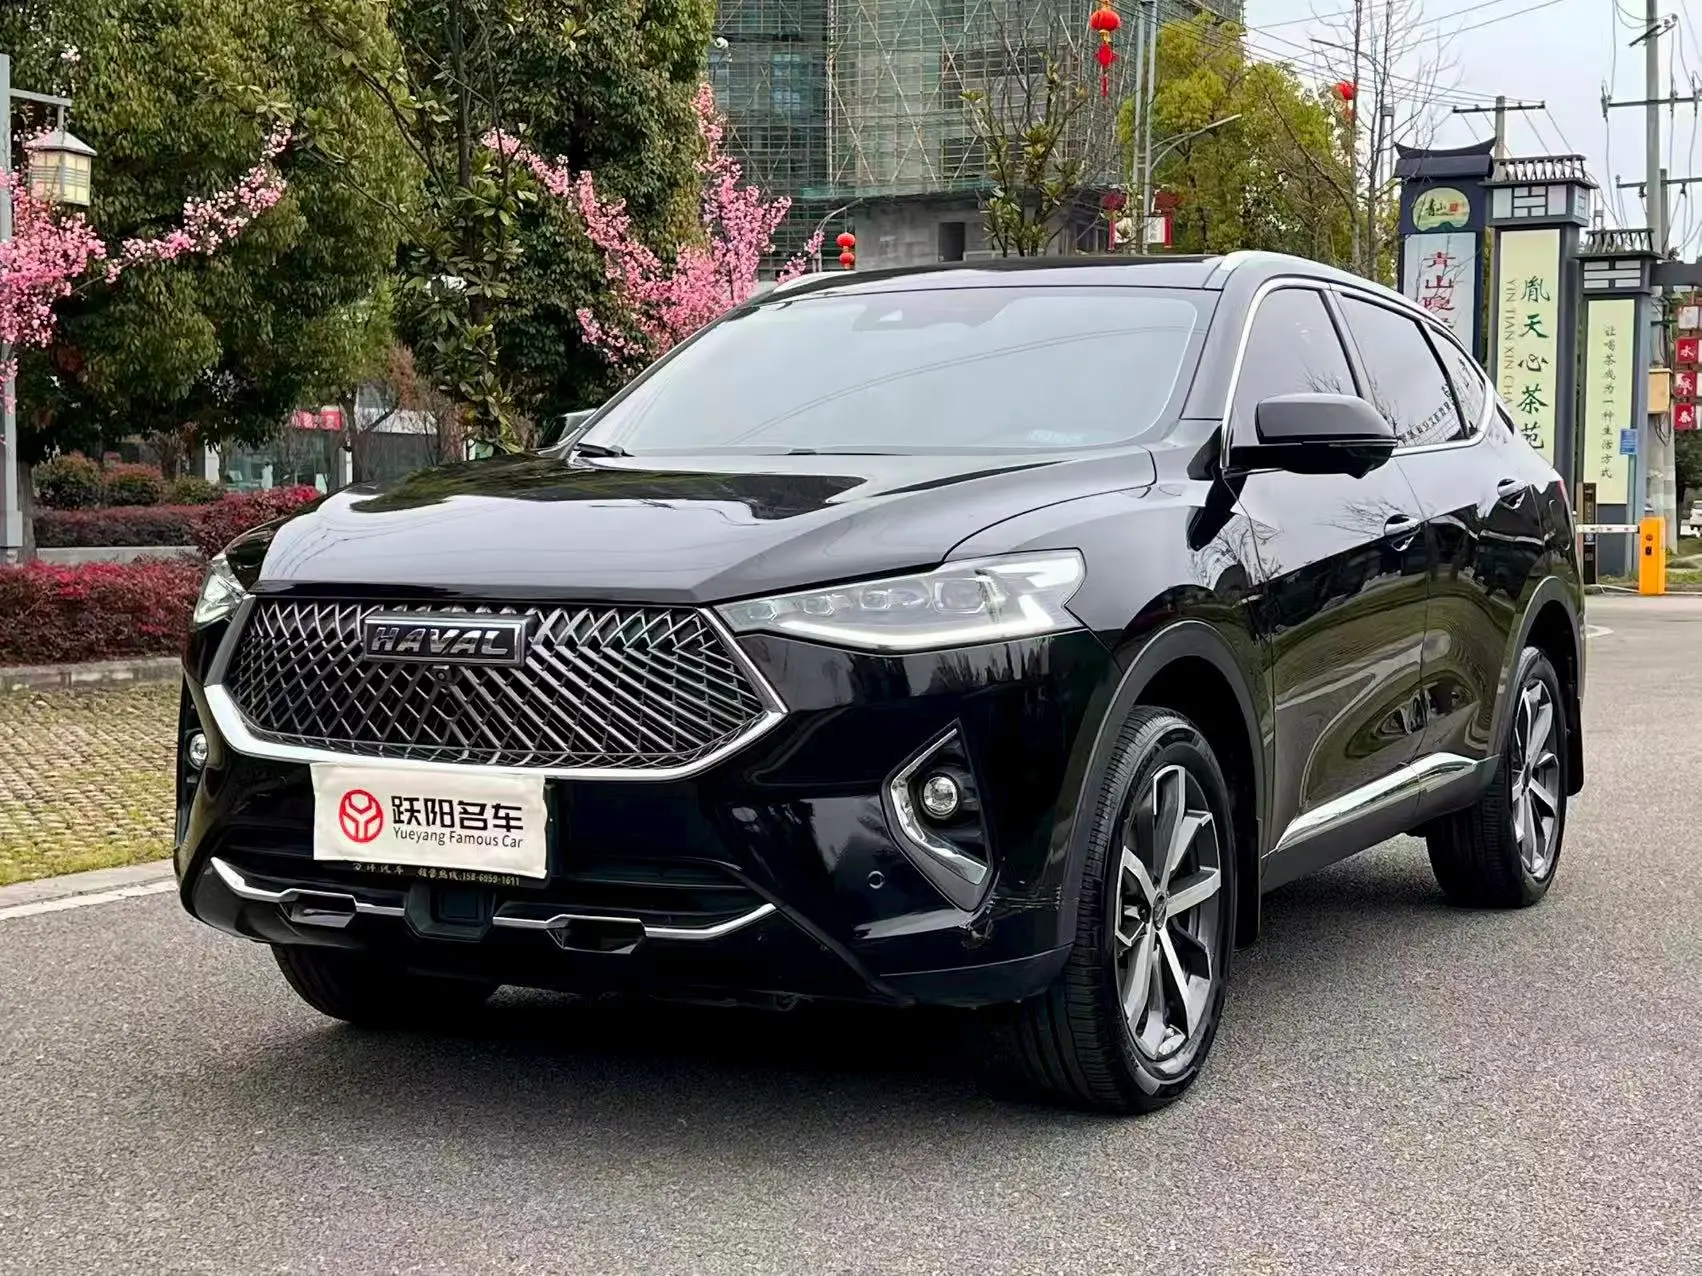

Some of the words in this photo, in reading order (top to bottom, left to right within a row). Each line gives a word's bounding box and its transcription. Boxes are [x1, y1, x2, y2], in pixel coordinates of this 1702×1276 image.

[1505, 279, 1517, 302] YIN
[1504, 310, 1516, 340] TIAN
[1503, 347, 1515, 370] XIN
[1516, 275, 1550, 450] 胤天心茶苑
[371, 627, 508, 655] HAVAL
[391, 796, 523, 832] 跃阳名车
[393, 827, 445, 846] Yueyang
[449, 831, 499, 846] Famous
[502, 835, 523, 848] Car
